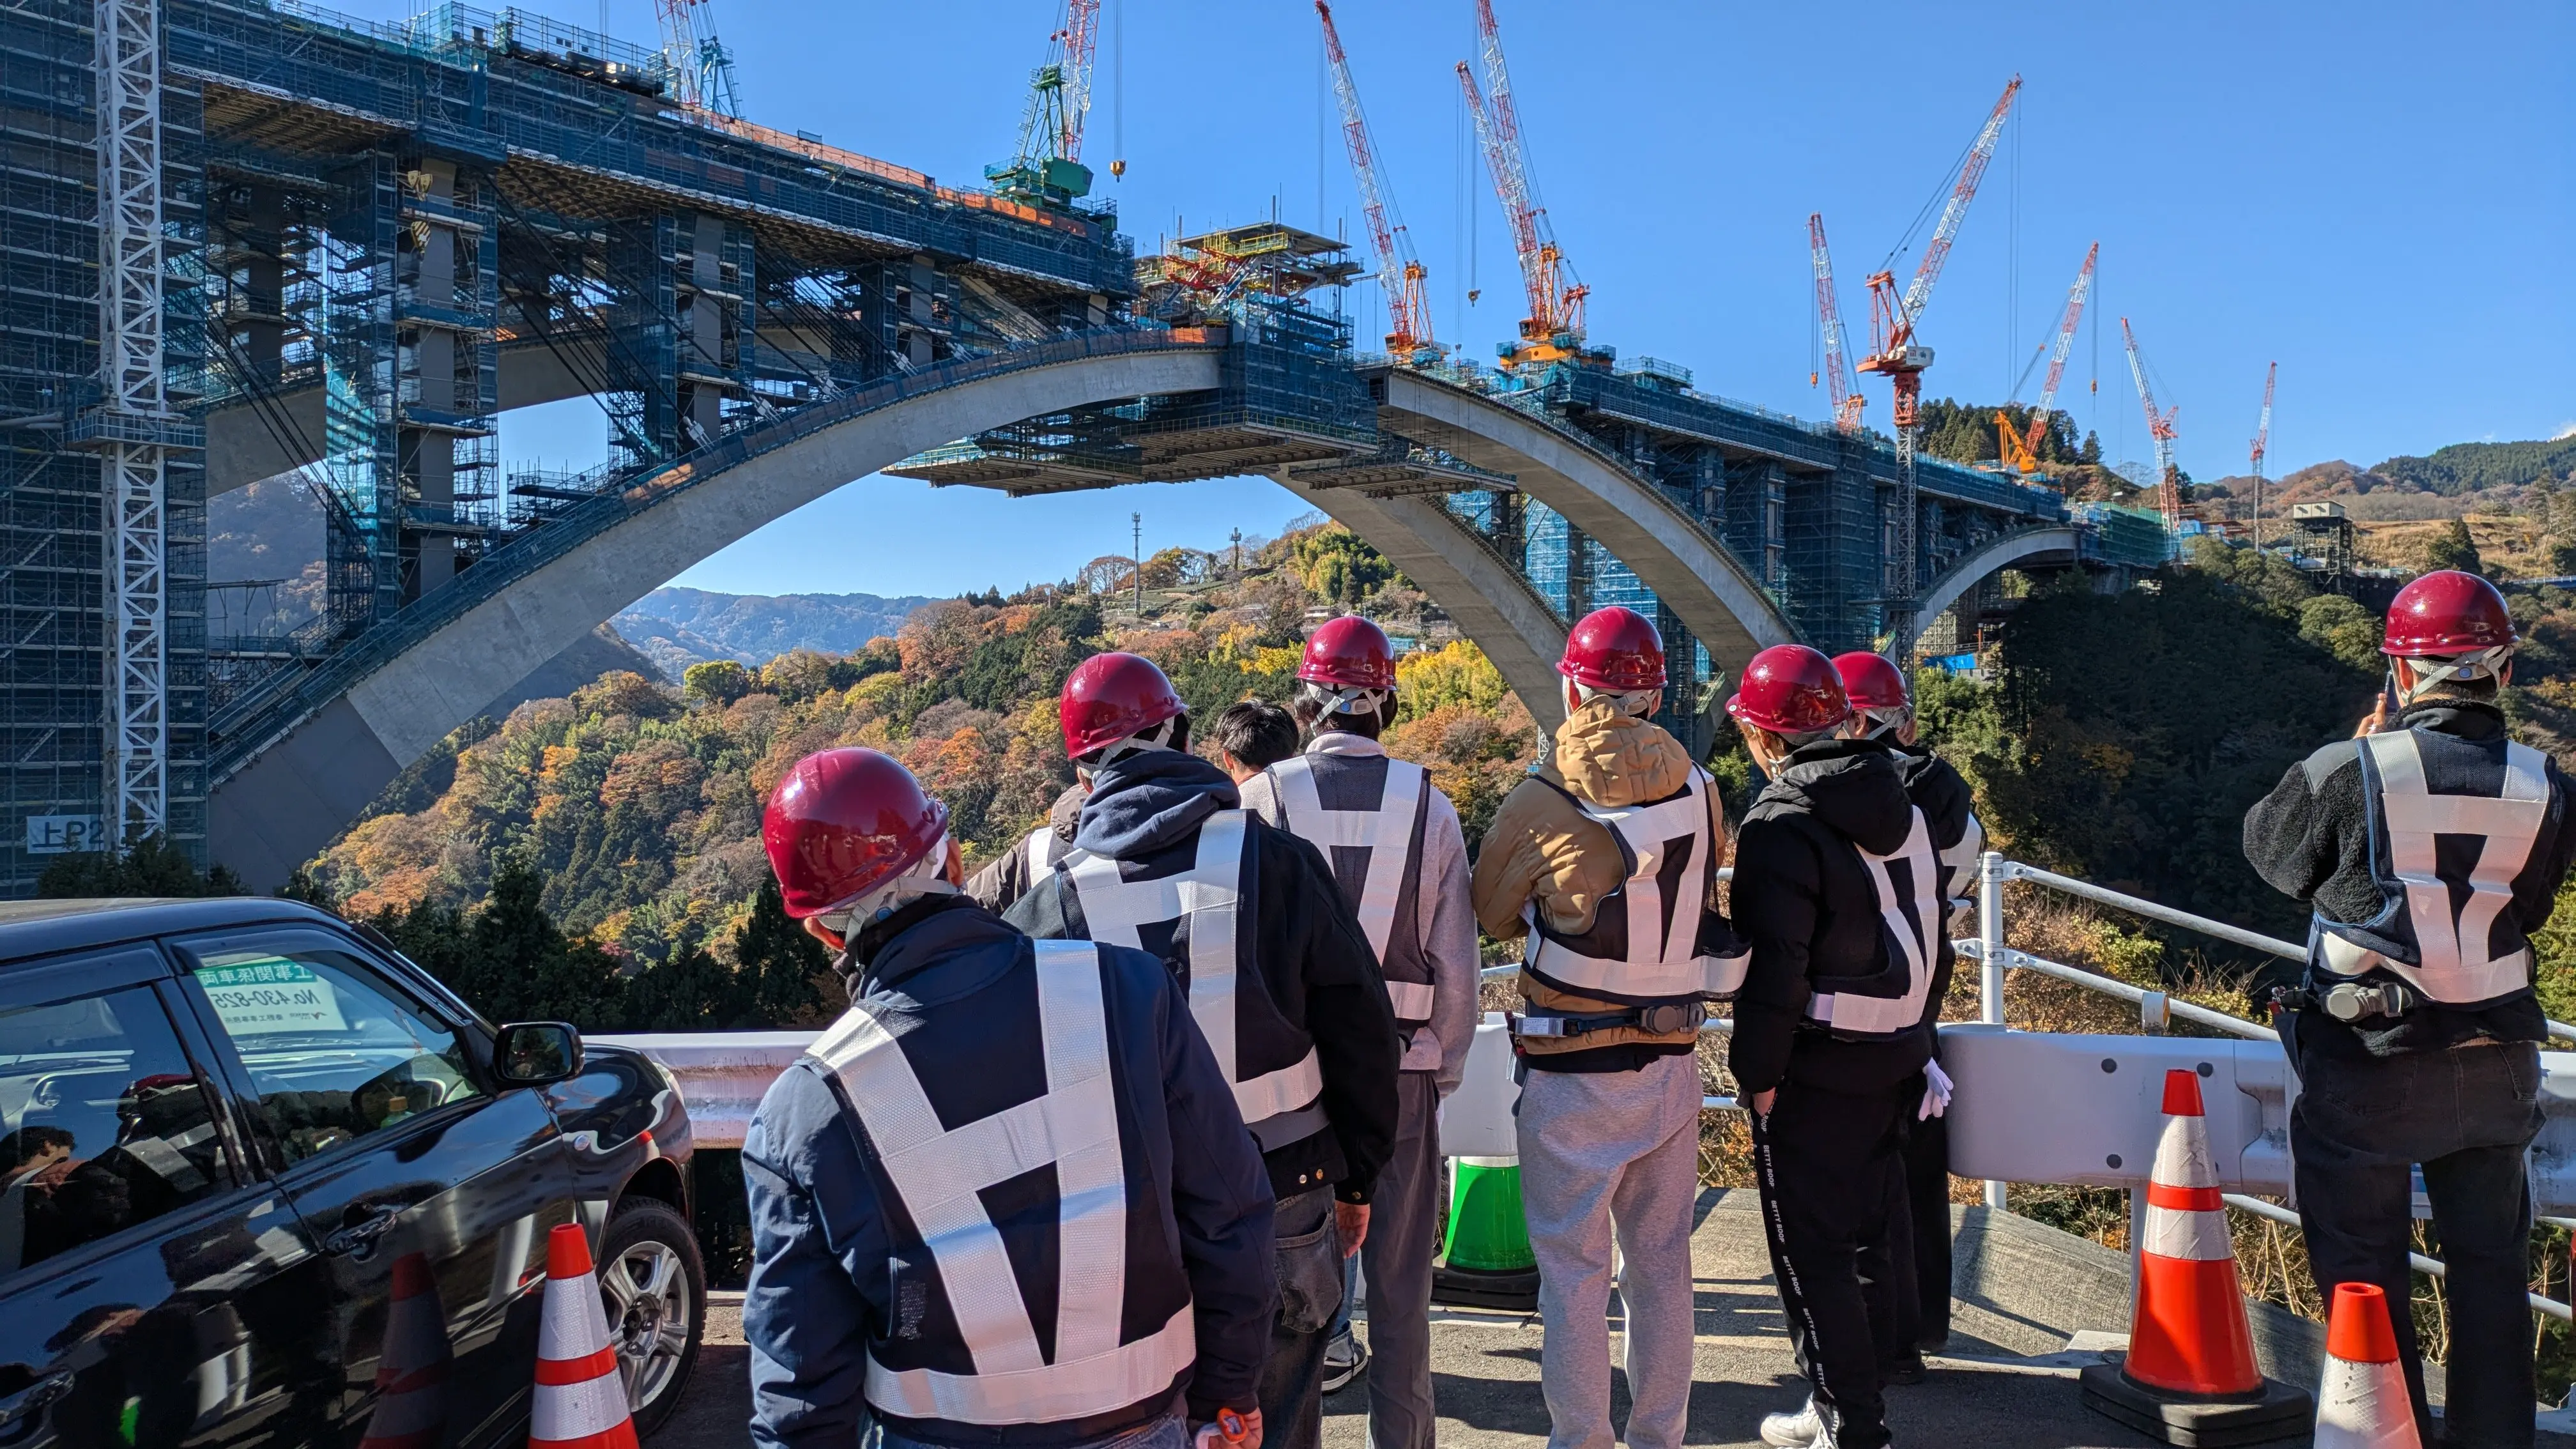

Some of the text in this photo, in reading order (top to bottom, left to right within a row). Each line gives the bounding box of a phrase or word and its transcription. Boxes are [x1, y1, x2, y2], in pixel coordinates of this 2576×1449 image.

[1763, 1145, 1772, 1167] BETTY
[1771, 1200, 1781, 1222] BETTY
[1782, 1255, 1802, 1296] BETTY BOOP
[1804, 1308, 1814, 1330] BETTY
[1816, 1363, 1826, 1386] BETTY
[1831, 1411, 1839, 1432] BETTY
